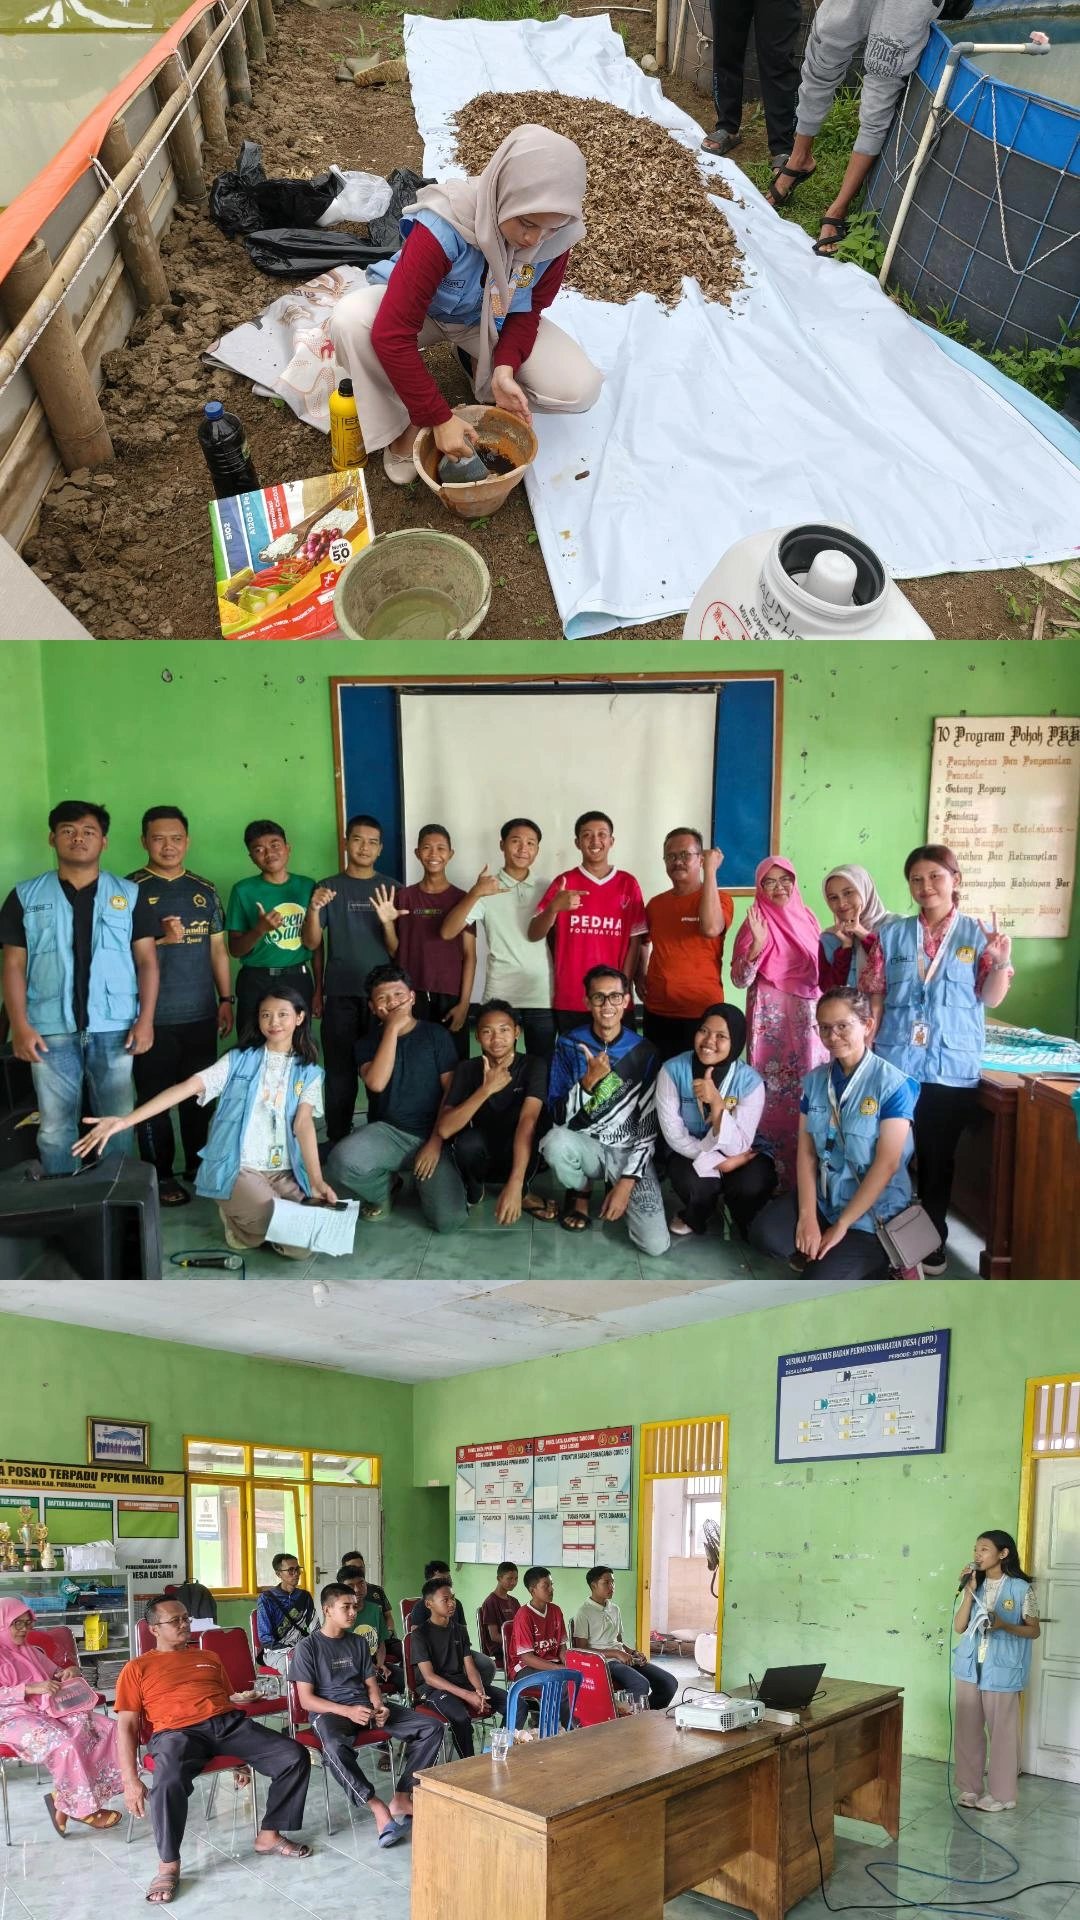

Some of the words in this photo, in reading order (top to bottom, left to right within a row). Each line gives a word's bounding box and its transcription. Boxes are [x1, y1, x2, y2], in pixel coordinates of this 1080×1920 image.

[332, 548, 350, 561] 50
[937, 726, 951, 742] 10
[953, 726, 1005, 747] Program
[902, 1338, 917, 1348] DESA
[8, 1465, 47, 1479] POSKO
[49, 1468, 98, 1481] TERPADU
[100, 1472, 130, 1484] PPKM
[132, 1474, 164, 1485] MIKRO
[149, 1571, 174, 1579] LOSARI
